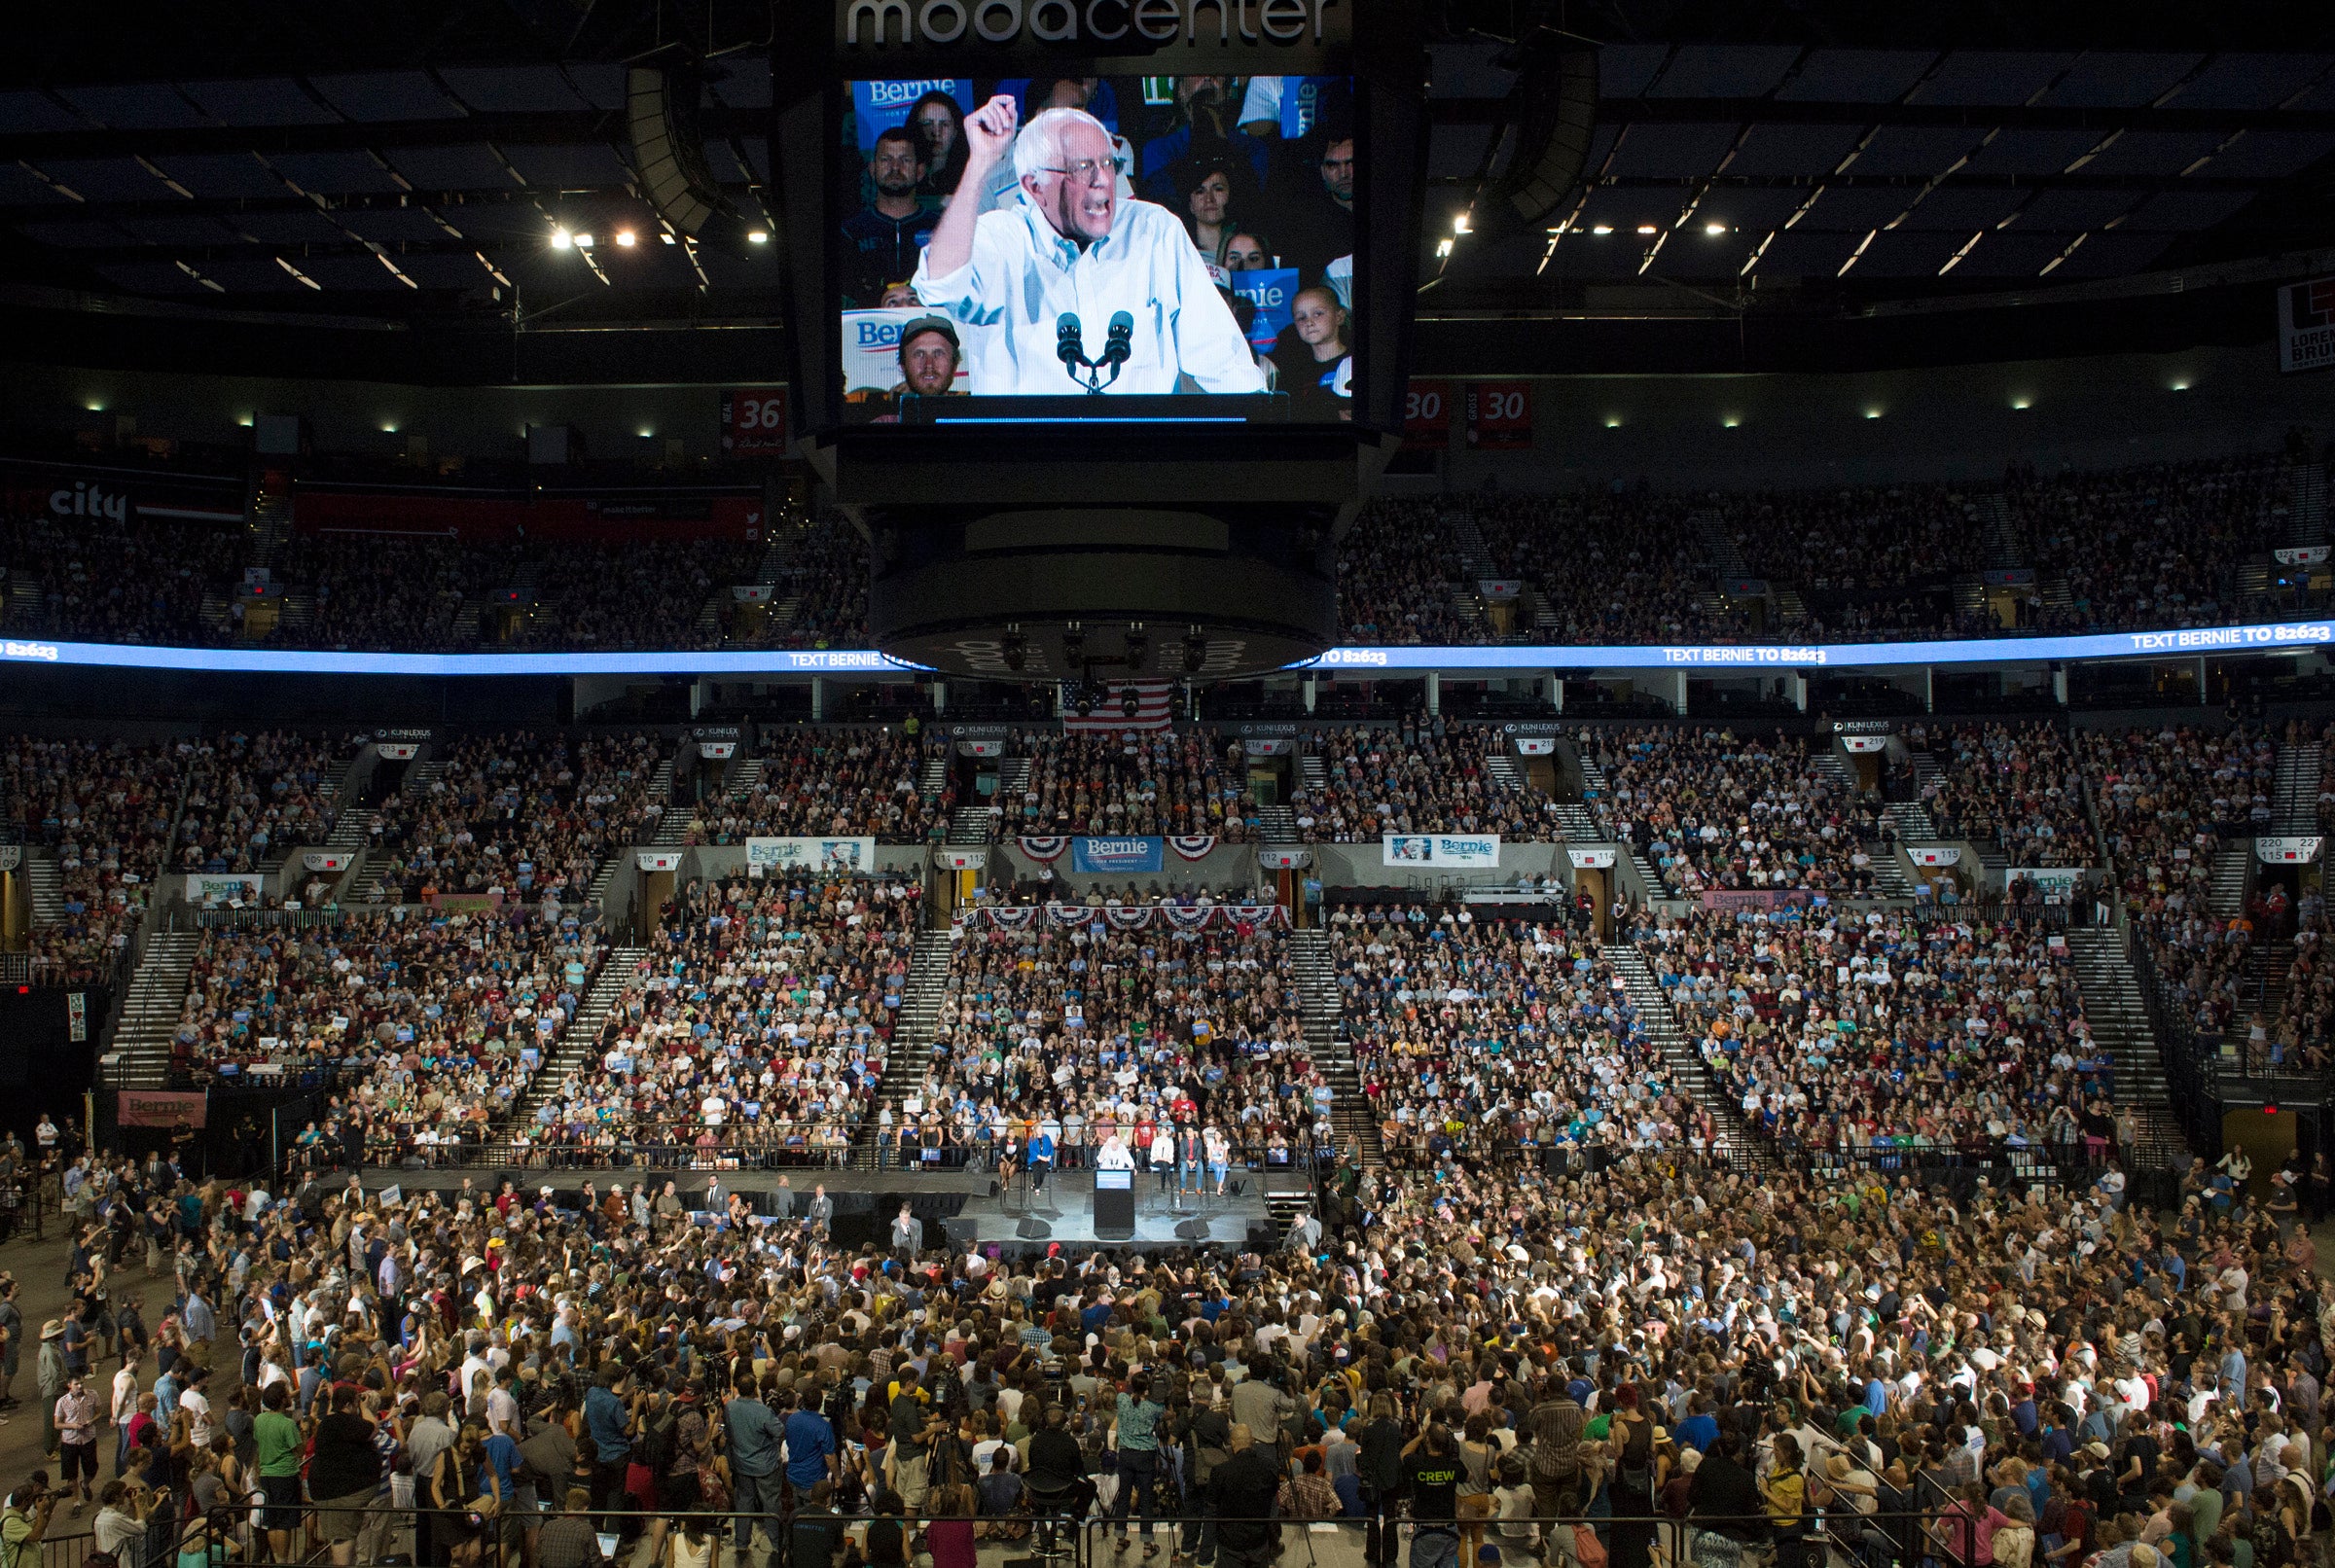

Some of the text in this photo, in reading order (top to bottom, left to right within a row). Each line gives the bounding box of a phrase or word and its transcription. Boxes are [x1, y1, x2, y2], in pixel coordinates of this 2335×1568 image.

[857, 321, 905, 344] Ber
[1404, 391, 1441, 420] 30
[1485, 391, 1526, 420] 30
[739, 399, 780, 429] 36
[48, 481, 126, 527] city
[2131, 624, 2330, 649] TEXT BERNIE TO 82623
[5, 642, 58, 661] 82623
[1342, 650, 1386, 665] 82623
[1662, 647, 1826, 664] TEXT BERNIE TO 82623
[789, 653, 828, 666] TEXT
[829, 653, 880, 666] BERNIE
[751, 842, 802, 855] Bernie
[1087, 837, 1148, 854] Bernie
[1441, 839, 1492, 852] Bernie
[2261, 838, 2282, 847] 220
[305, 855, 322, 864] 109
[1941, 850, 1958, 859] 115
[2261, 851, 2282, 860] 115
[201, 880, 243, 891] Berni
[2037, 874, 2072, 887] rnie
[1713, 892, 1767, 905] Bernie
[129, 1096, 195, 1113] Bernie
[1417, 1470, 1455, 1481] CREW
